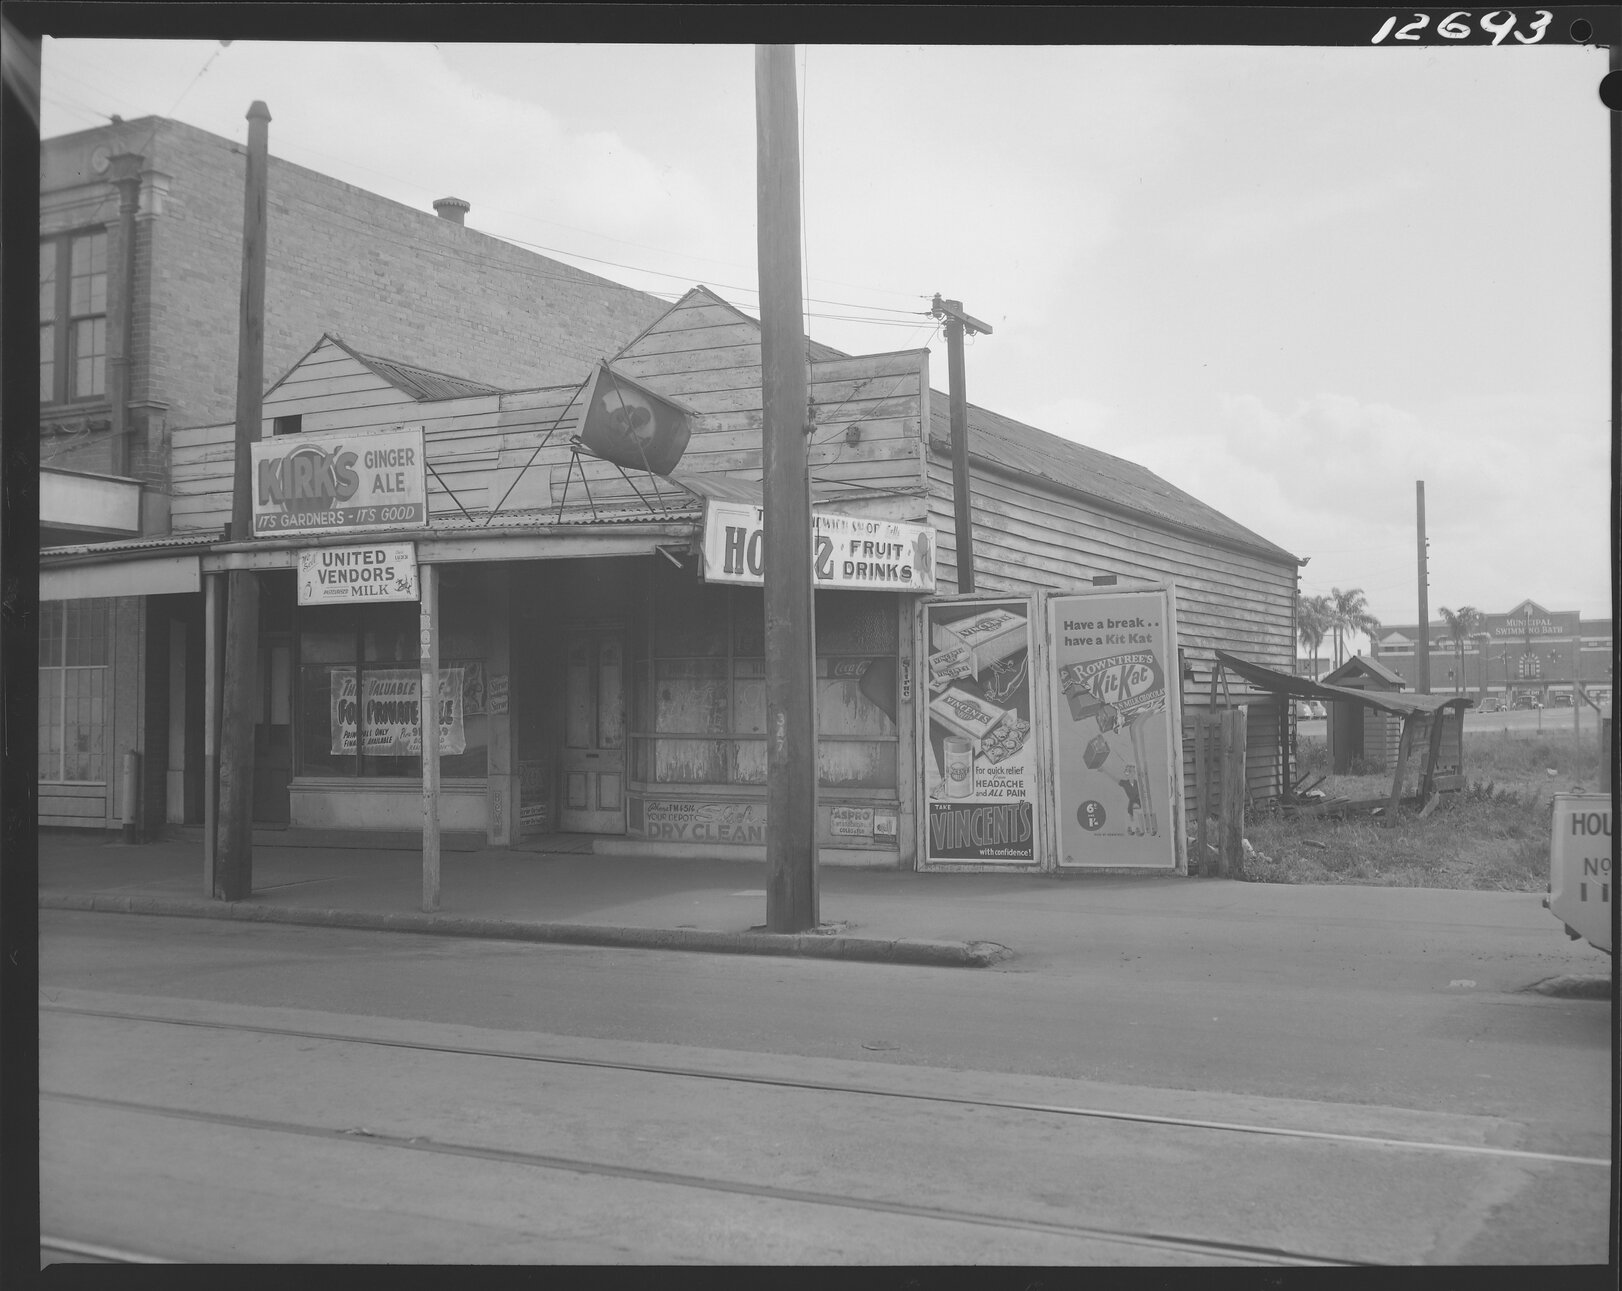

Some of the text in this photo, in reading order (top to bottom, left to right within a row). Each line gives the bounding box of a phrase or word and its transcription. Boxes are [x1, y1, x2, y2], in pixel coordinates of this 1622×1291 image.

[364, 448, 415, 469] GINGER
[258, 445, 360, 506] KIRK'S
[372, 472, 405, 494] ALE
[281, 511, 345, 527] GARDNERS
[381, 506, 415, 521] GOOD
[850, 540, 904, 559] FRUIT
[322, 550, 386, 567] UNITED
[318, 567, 395, 584] VENDORS
[842, 561, 913, 582] DRINKS
[351, 584, 389, 597] MILK
[1064, 620, 1094, 631] Have
[1096, 621, 1104, 630] a
[1107, 617, 1145, 629] break
[1495, 627, 1540, 636] SWIMMNG
[1064, 633, 1153, 647] have a Kit Kat
[1073, 655, 1154, 681] ROWNTREE'S
[368, 680, 417, 696] VALUABLE
[1093, 665, 1149, 701] Kit Kat
[975, 766, 986, 775] For
[987, 765, 1005, 777] quick
[1005, 766, 1025, 775] relief
[976, 780, 1024, 788] HEADACHE
[976, 789, 1026, 797] and ALL PAIN
[834, 811, 870, 821] ASPRO
[648, 822, 768, 842] DRY CLEAN
[930, 800, 1032, 851] VINCENT'S
[979, 848, 1032, 857] with confidence!
